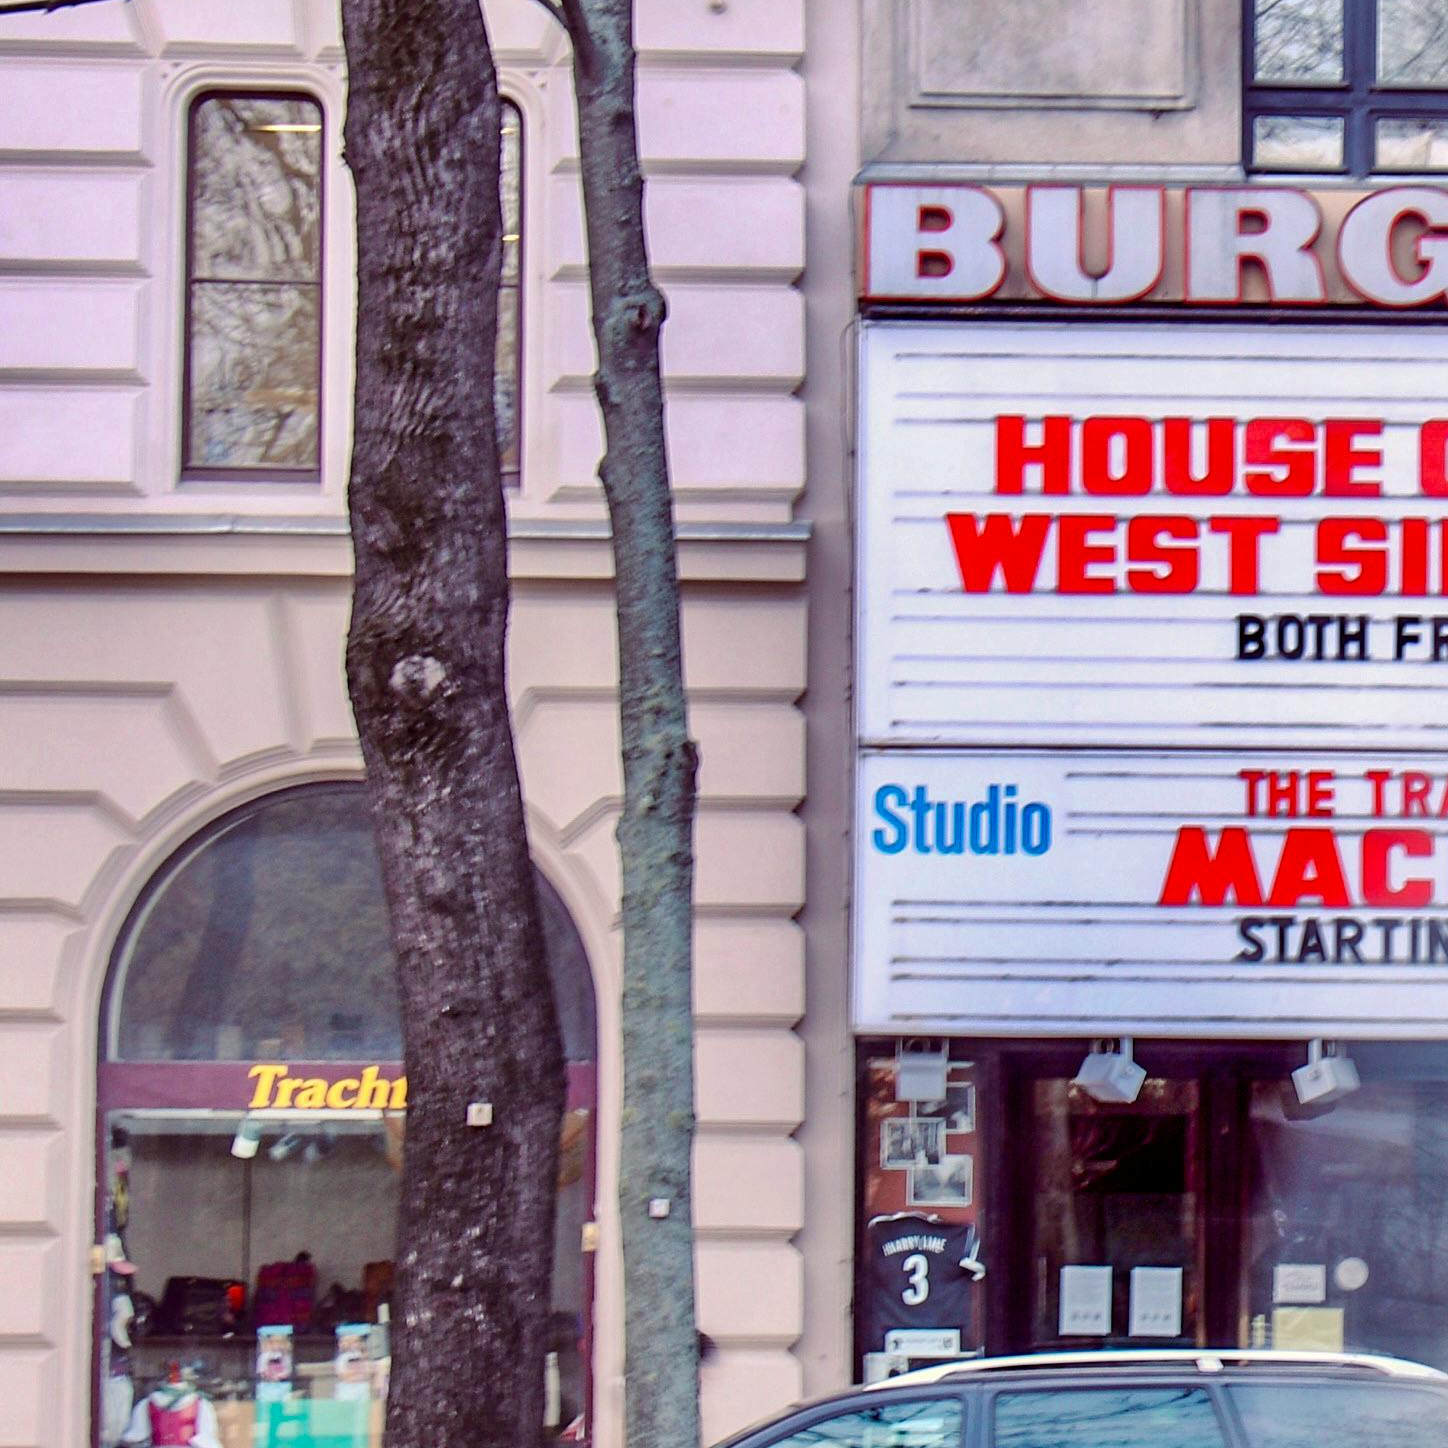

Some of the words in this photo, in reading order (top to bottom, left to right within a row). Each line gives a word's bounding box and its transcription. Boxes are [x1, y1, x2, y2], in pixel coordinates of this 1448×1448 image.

[995, 415, 1383, 498] HOUSE
[945, 512, 1280, 595] WEST
[1235, 616, 1370, 661] BOTH
[871, 782, 1052, 857] Studio
[1239, 770, 1335, 817] THE
[902, 1254, 929, 1306] 3
